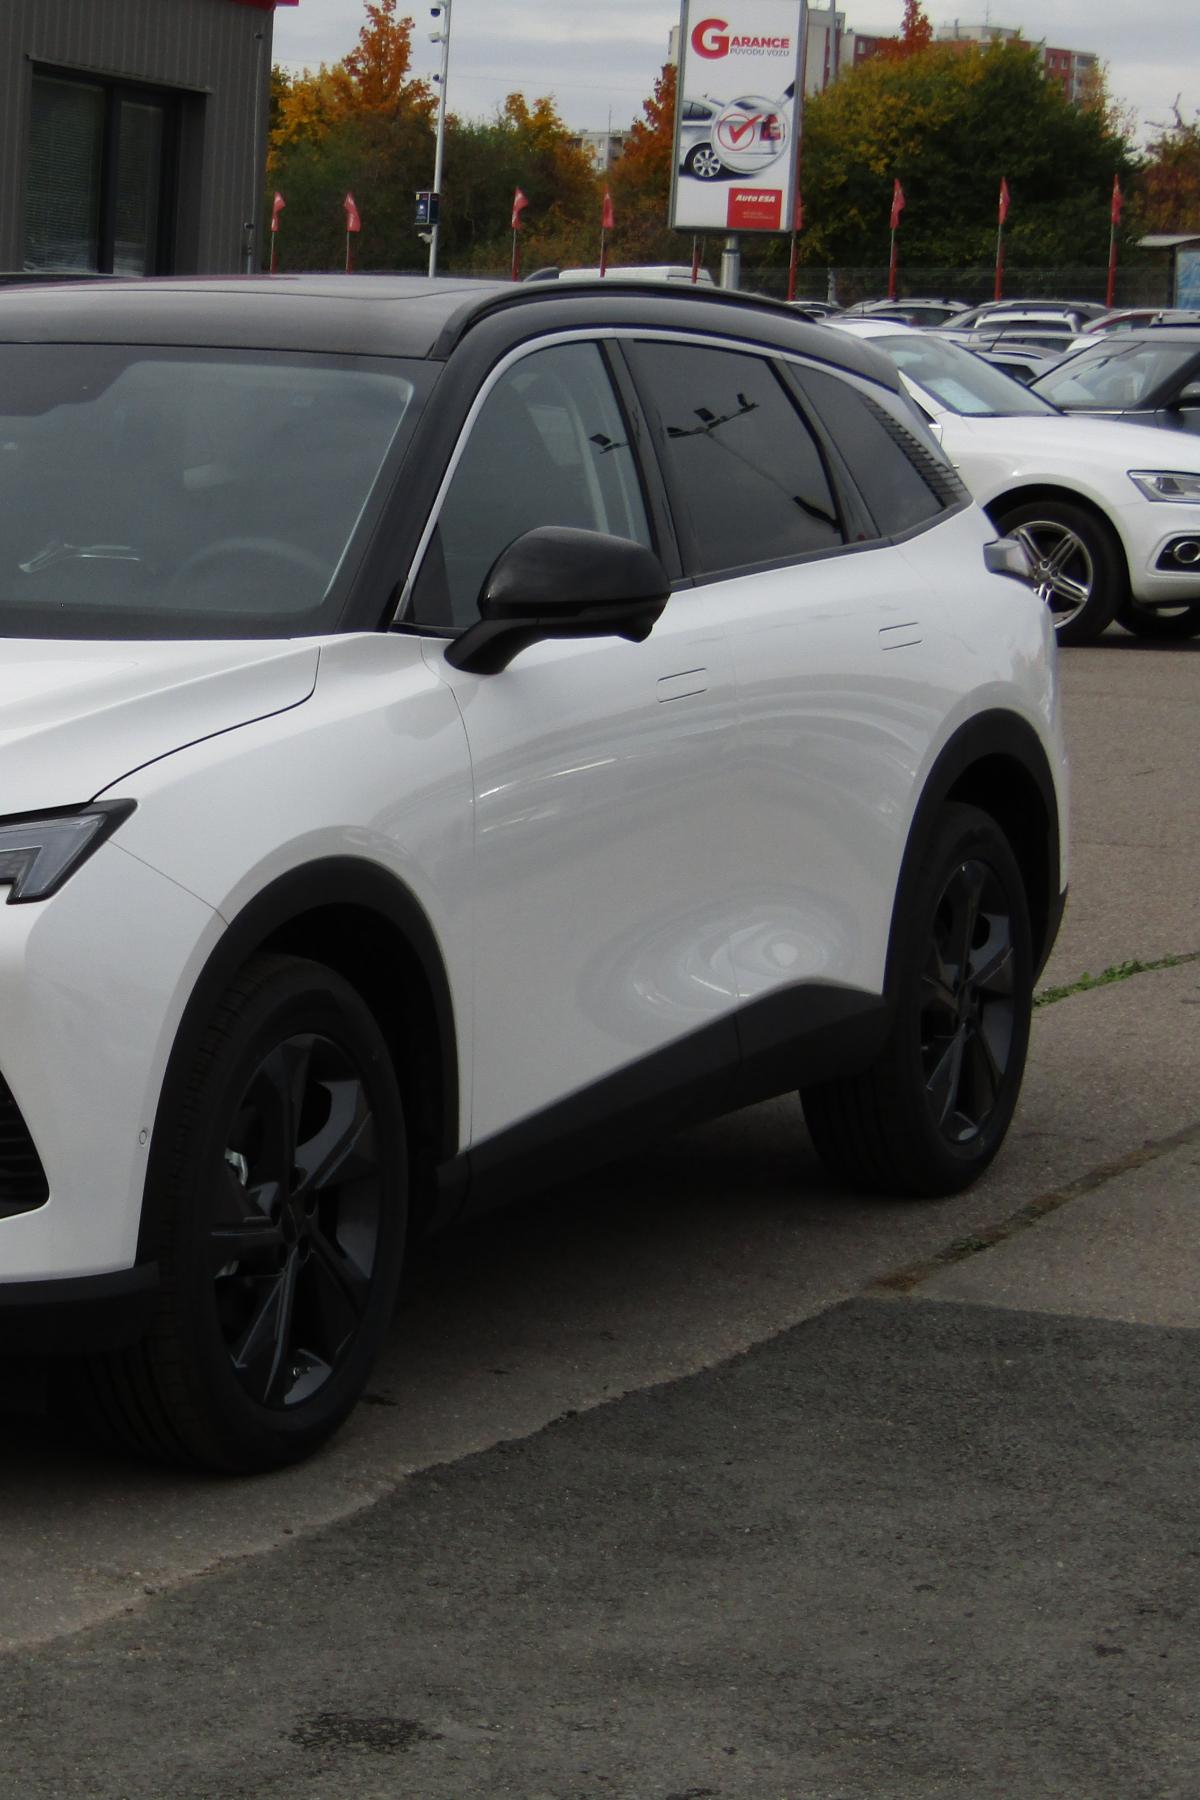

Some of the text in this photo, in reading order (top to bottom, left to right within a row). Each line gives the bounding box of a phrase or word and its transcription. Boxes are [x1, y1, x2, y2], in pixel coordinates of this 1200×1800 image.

[691, 18, 790, 60] GARANCE
[735, 193, 776, 203] Auto ESA
